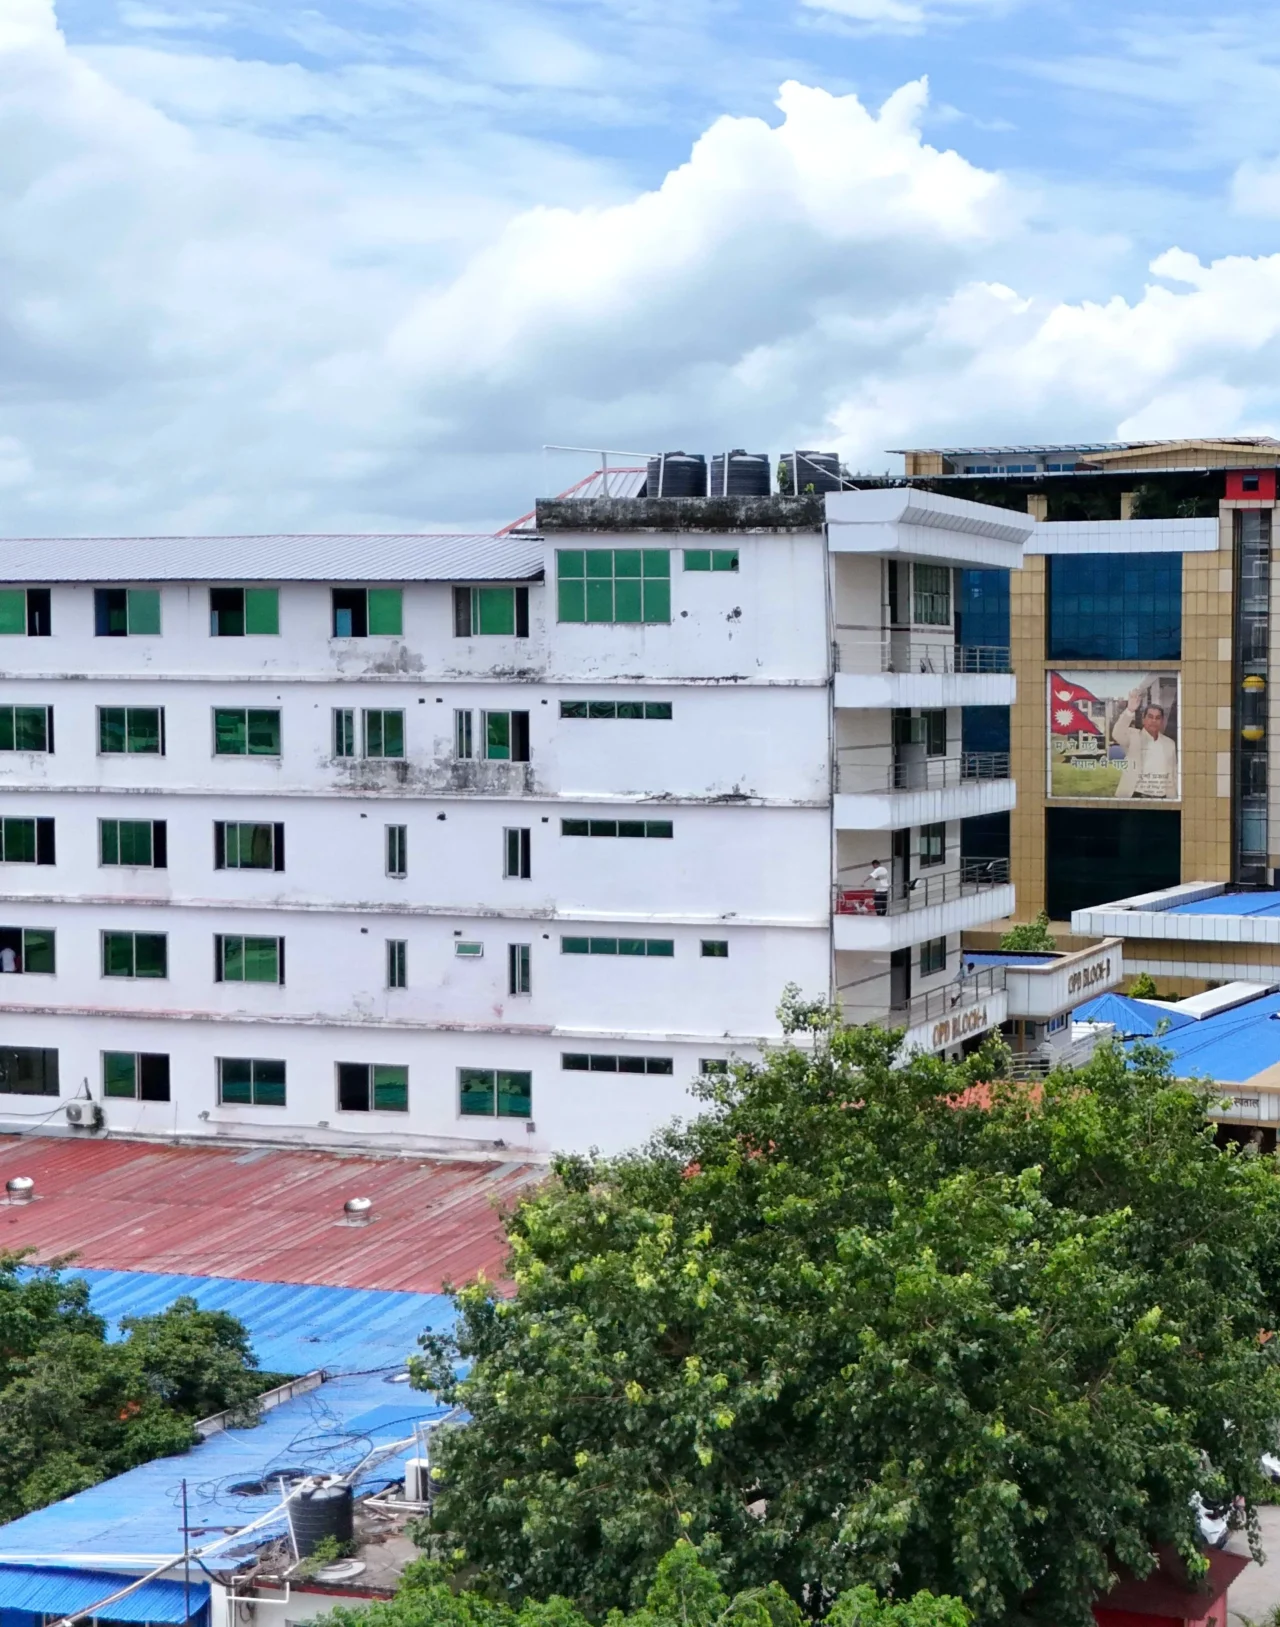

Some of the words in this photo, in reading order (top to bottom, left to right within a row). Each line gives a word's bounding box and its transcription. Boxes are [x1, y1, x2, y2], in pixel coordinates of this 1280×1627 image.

[1068, 971, 1081, 994] OPD
[933, 1020, 950, 1048] OPD
[952, 1005, 987, 1041] BLOCK-A
